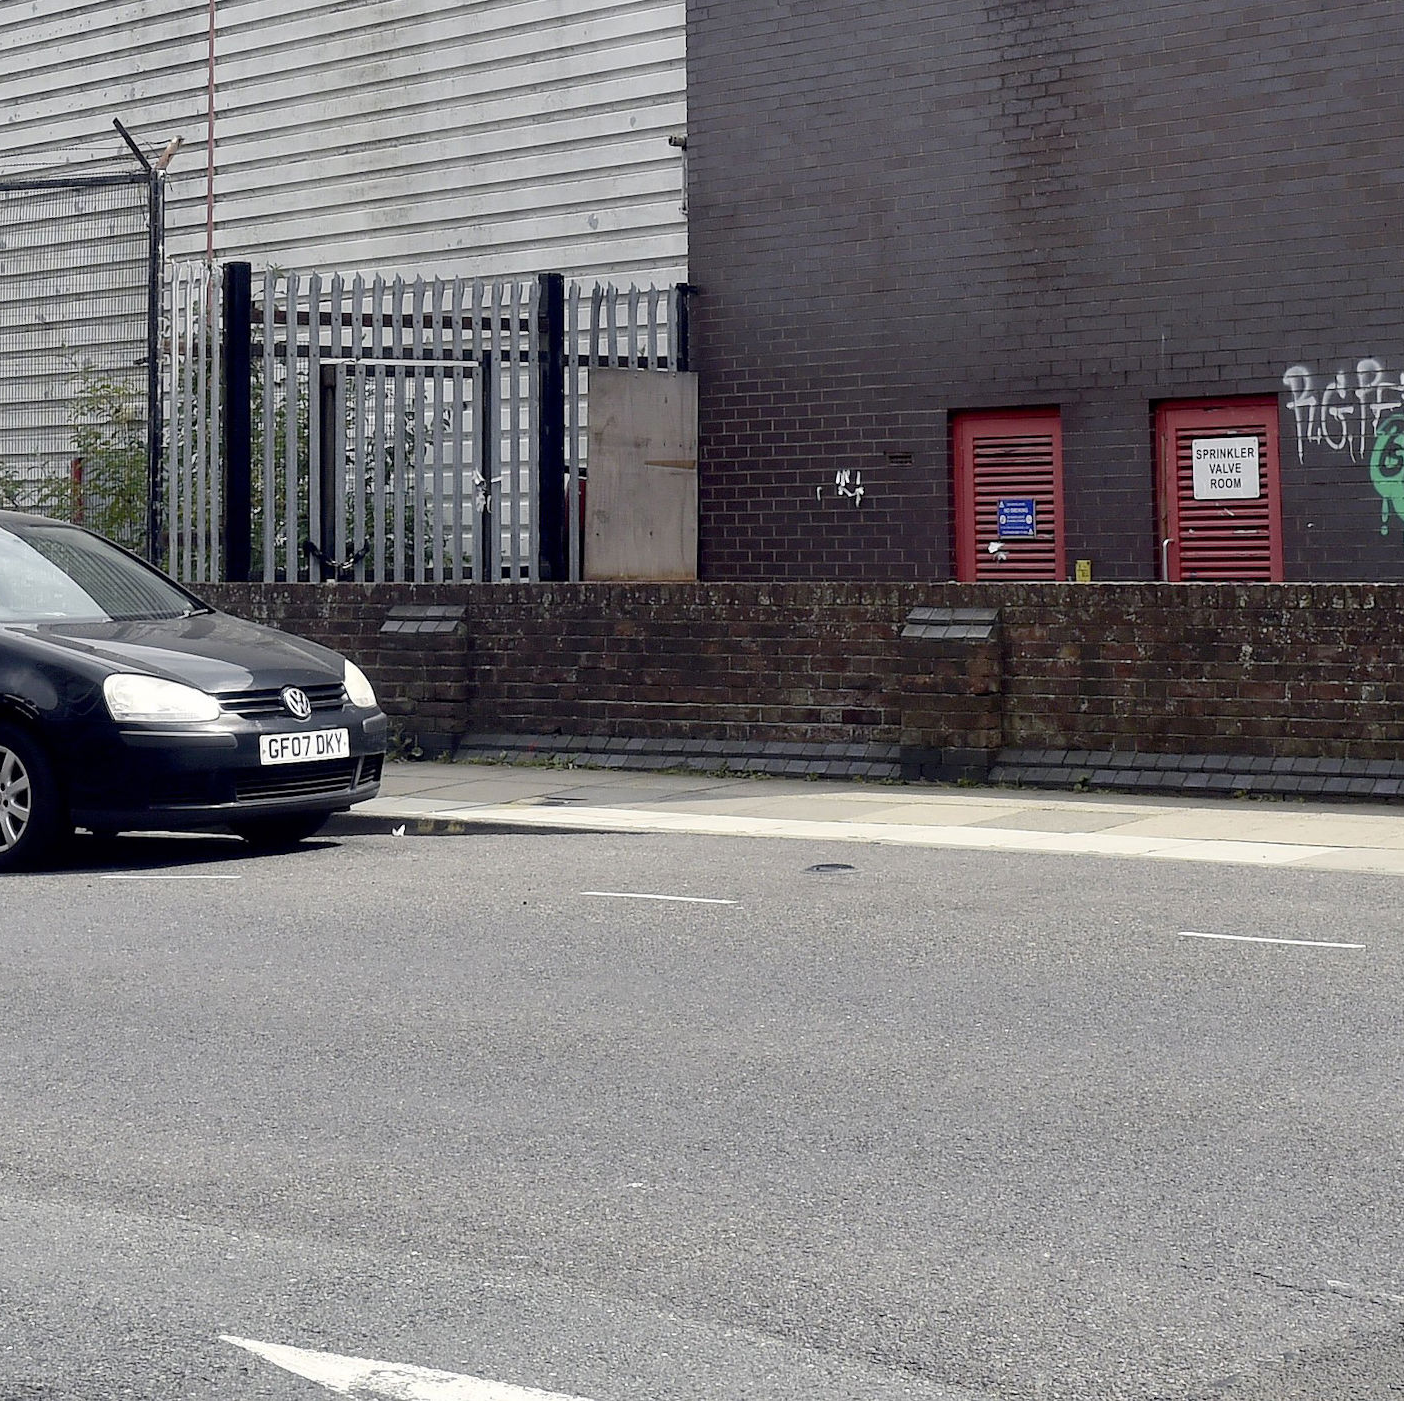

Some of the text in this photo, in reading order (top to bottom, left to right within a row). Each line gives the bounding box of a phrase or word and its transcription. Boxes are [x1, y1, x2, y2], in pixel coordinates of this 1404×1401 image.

[1196, 447, 1255, 460] SPRINKLER
[1209, 462, 1242, 474] VALVE
[1210, 478, 1242, 489] ROOM
[268, 732, 343, 759] GF07 DKY
